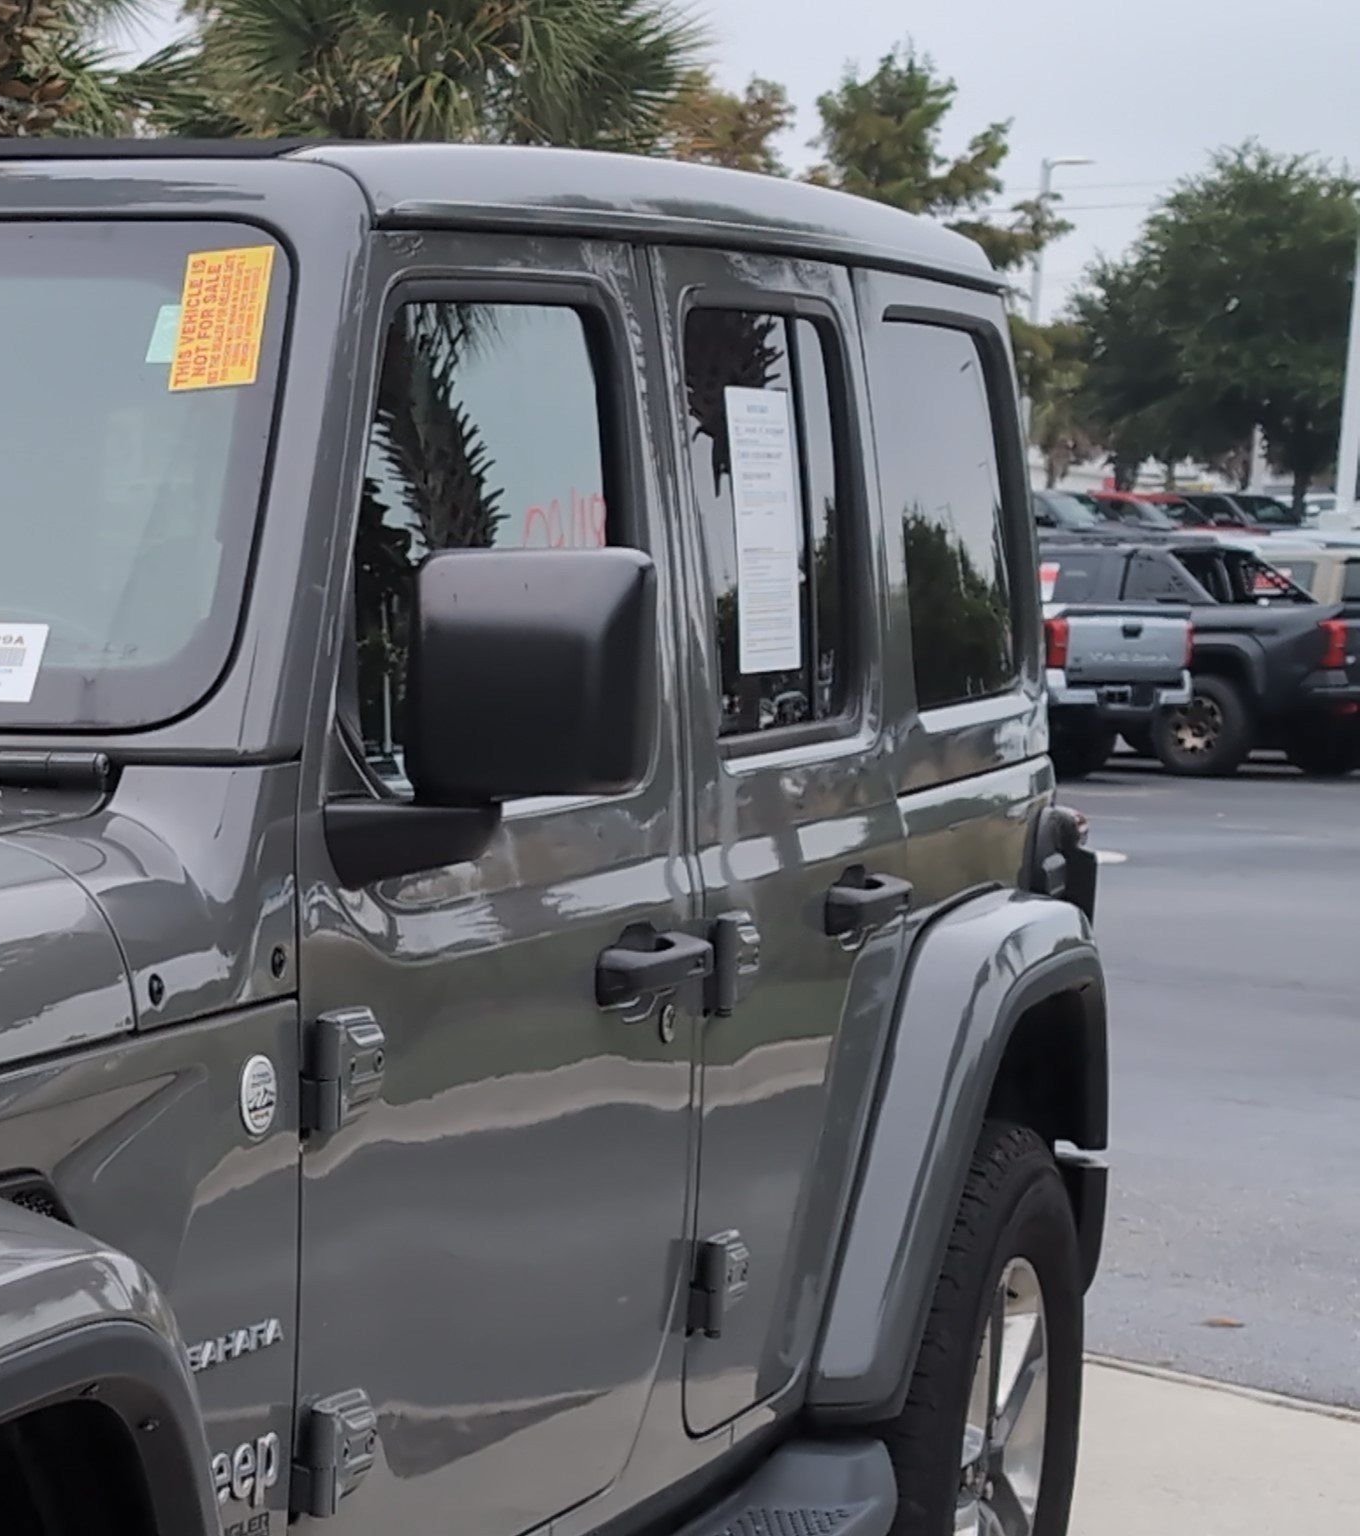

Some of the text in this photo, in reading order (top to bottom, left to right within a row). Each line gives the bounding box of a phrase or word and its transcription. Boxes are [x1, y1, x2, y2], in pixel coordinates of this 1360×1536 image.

[175, 259, 206, 386] THIS VEHICLE IS
[191, 263, 222, 377] NOT FOR SALE
[186, 1318, 284, 1373] SAHARA
[211, 1431, 280, 1507] eep
